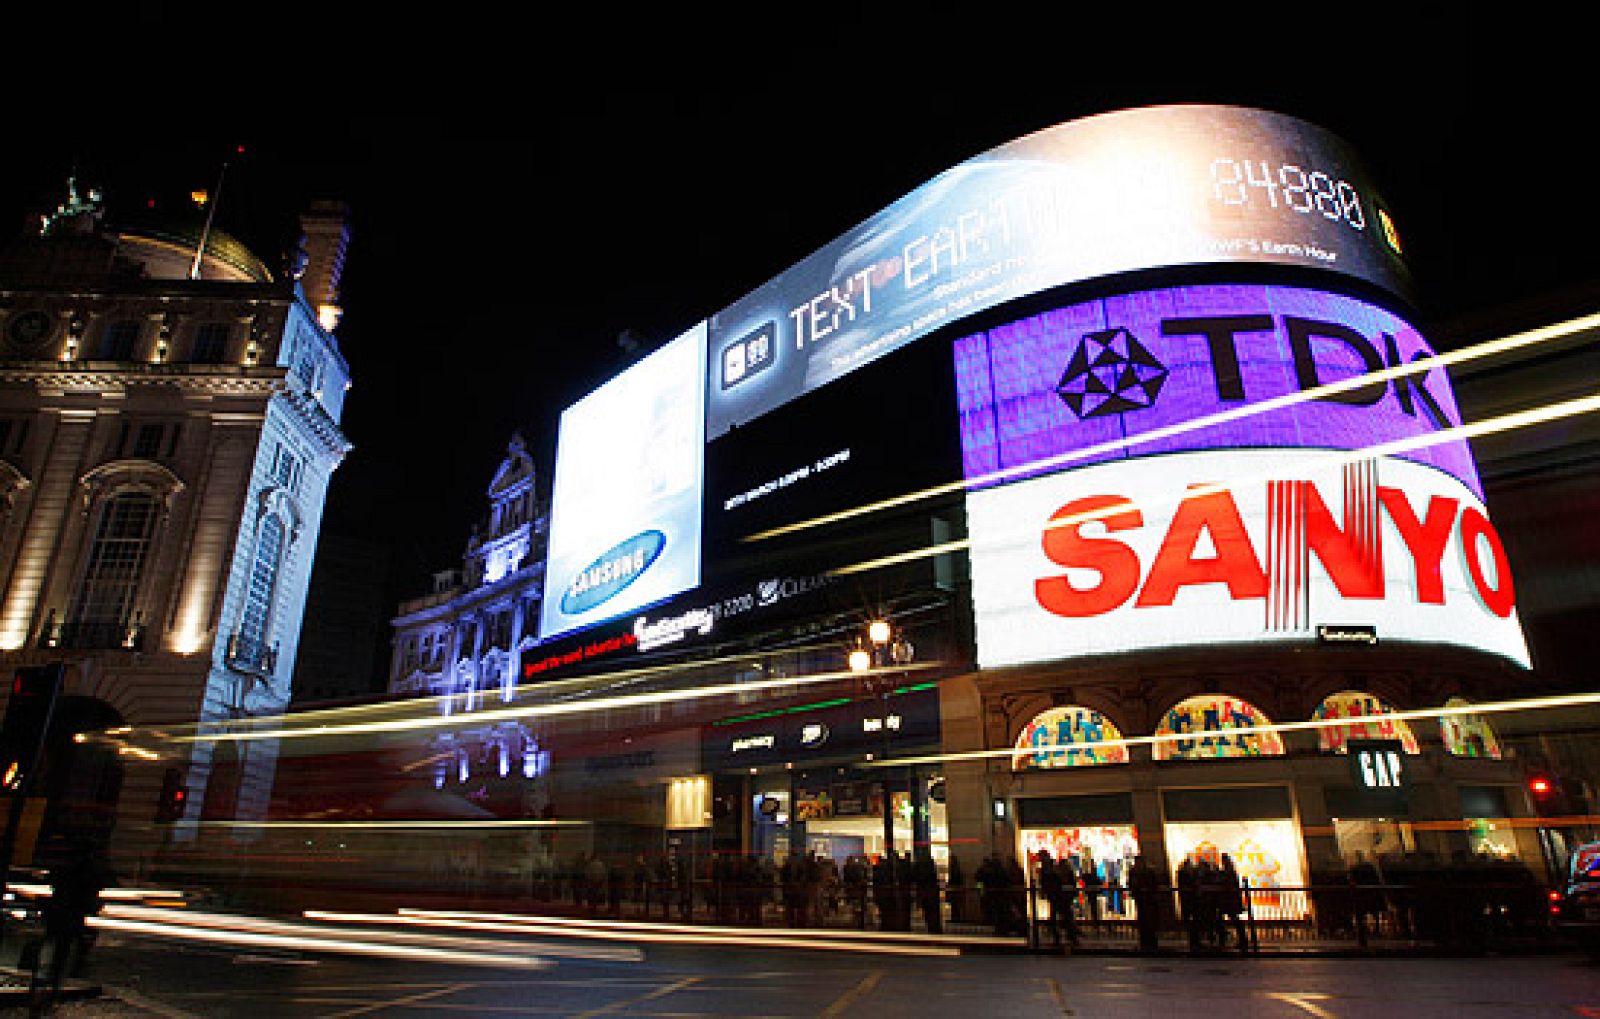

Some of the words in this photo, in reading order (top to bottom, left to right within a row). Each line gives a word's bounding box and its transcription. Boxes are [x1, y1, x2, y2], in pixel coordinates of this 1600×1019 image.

[789, 265, 877, 350] TEXT
[1160, 314, 1455, 429] TDK
[568, 547, 645, 598] SAMSUNG
[1034, 460, 1516, 632] SANYO
[1357, 750, 1403, 788] GAP
